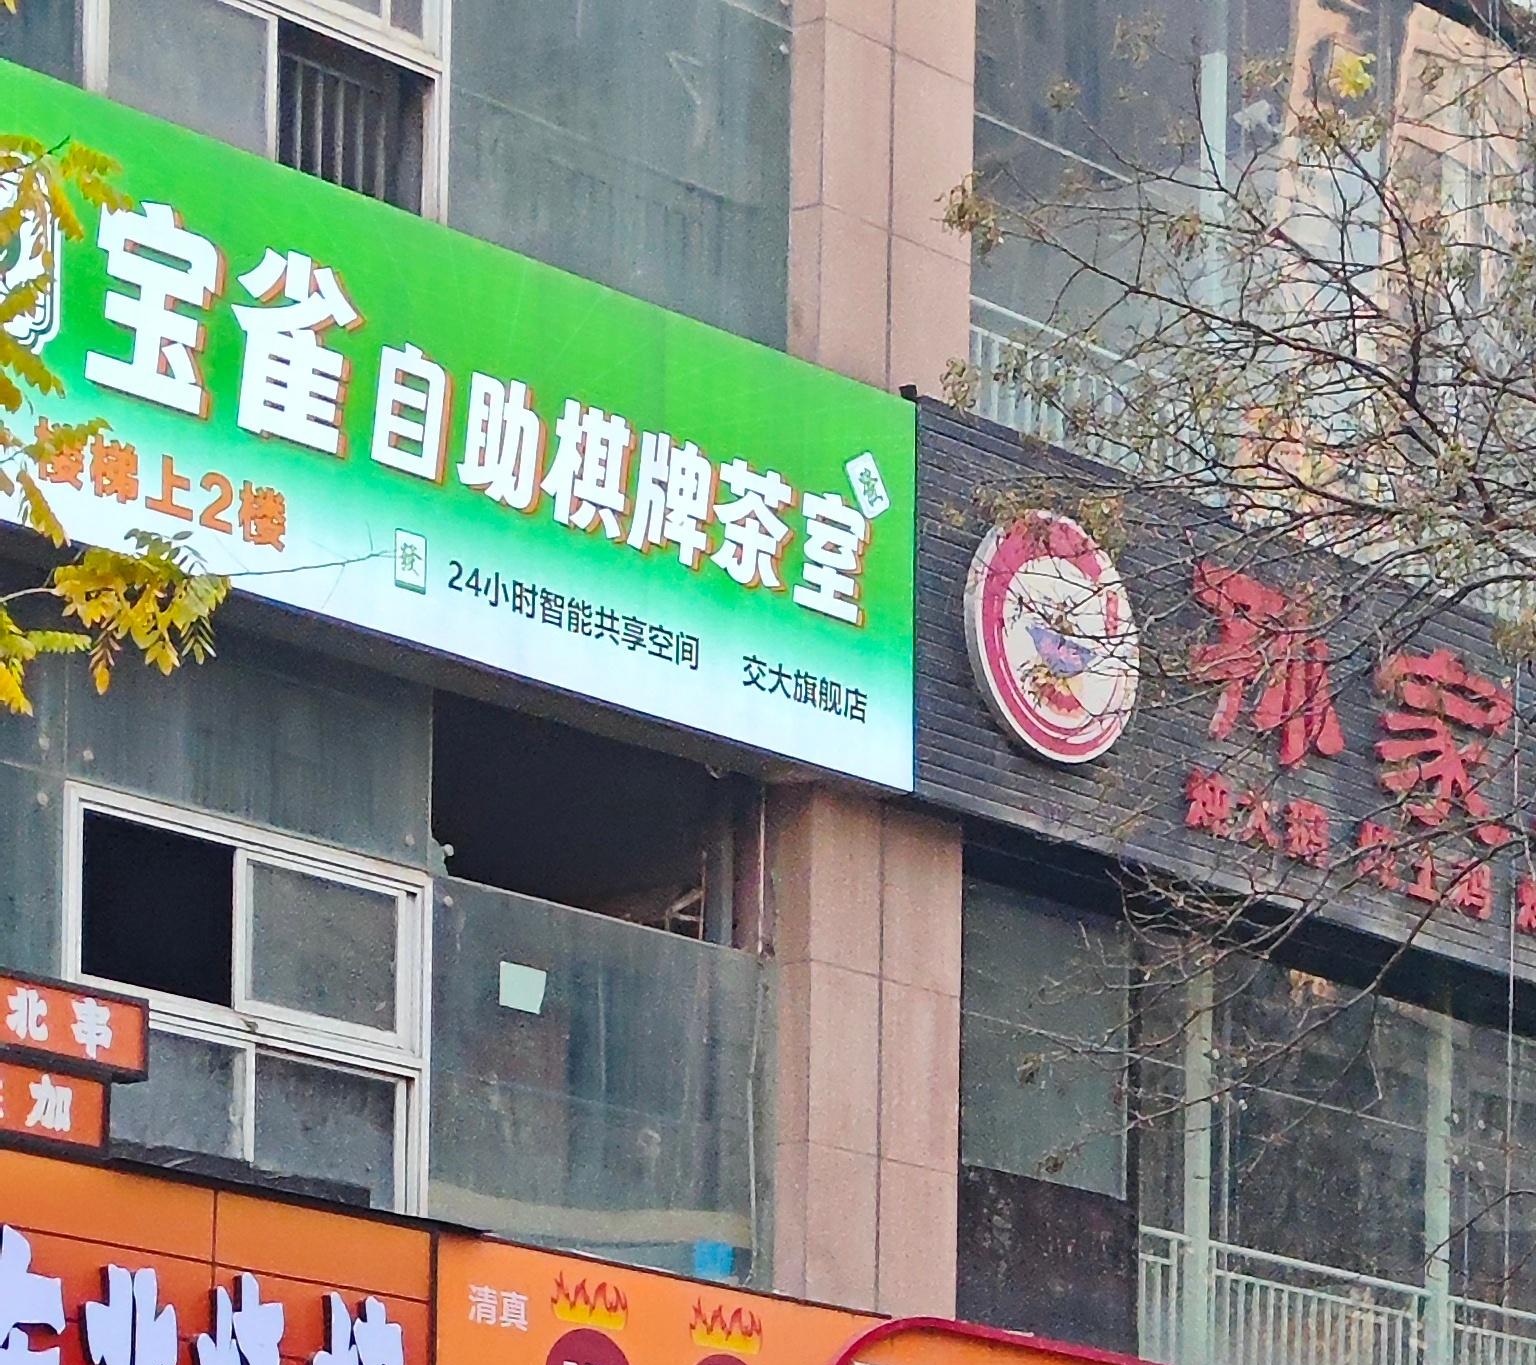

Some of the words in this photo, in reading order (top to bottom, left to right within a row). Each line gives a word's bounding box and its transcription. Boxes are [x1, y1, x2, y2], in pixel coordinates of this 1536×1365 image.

[448, 560, 699, 671] 24小时智能共享空间
[742, 654, 868, 723] 交大旗舰店
[468, 1283, 529, 1333] 清真
